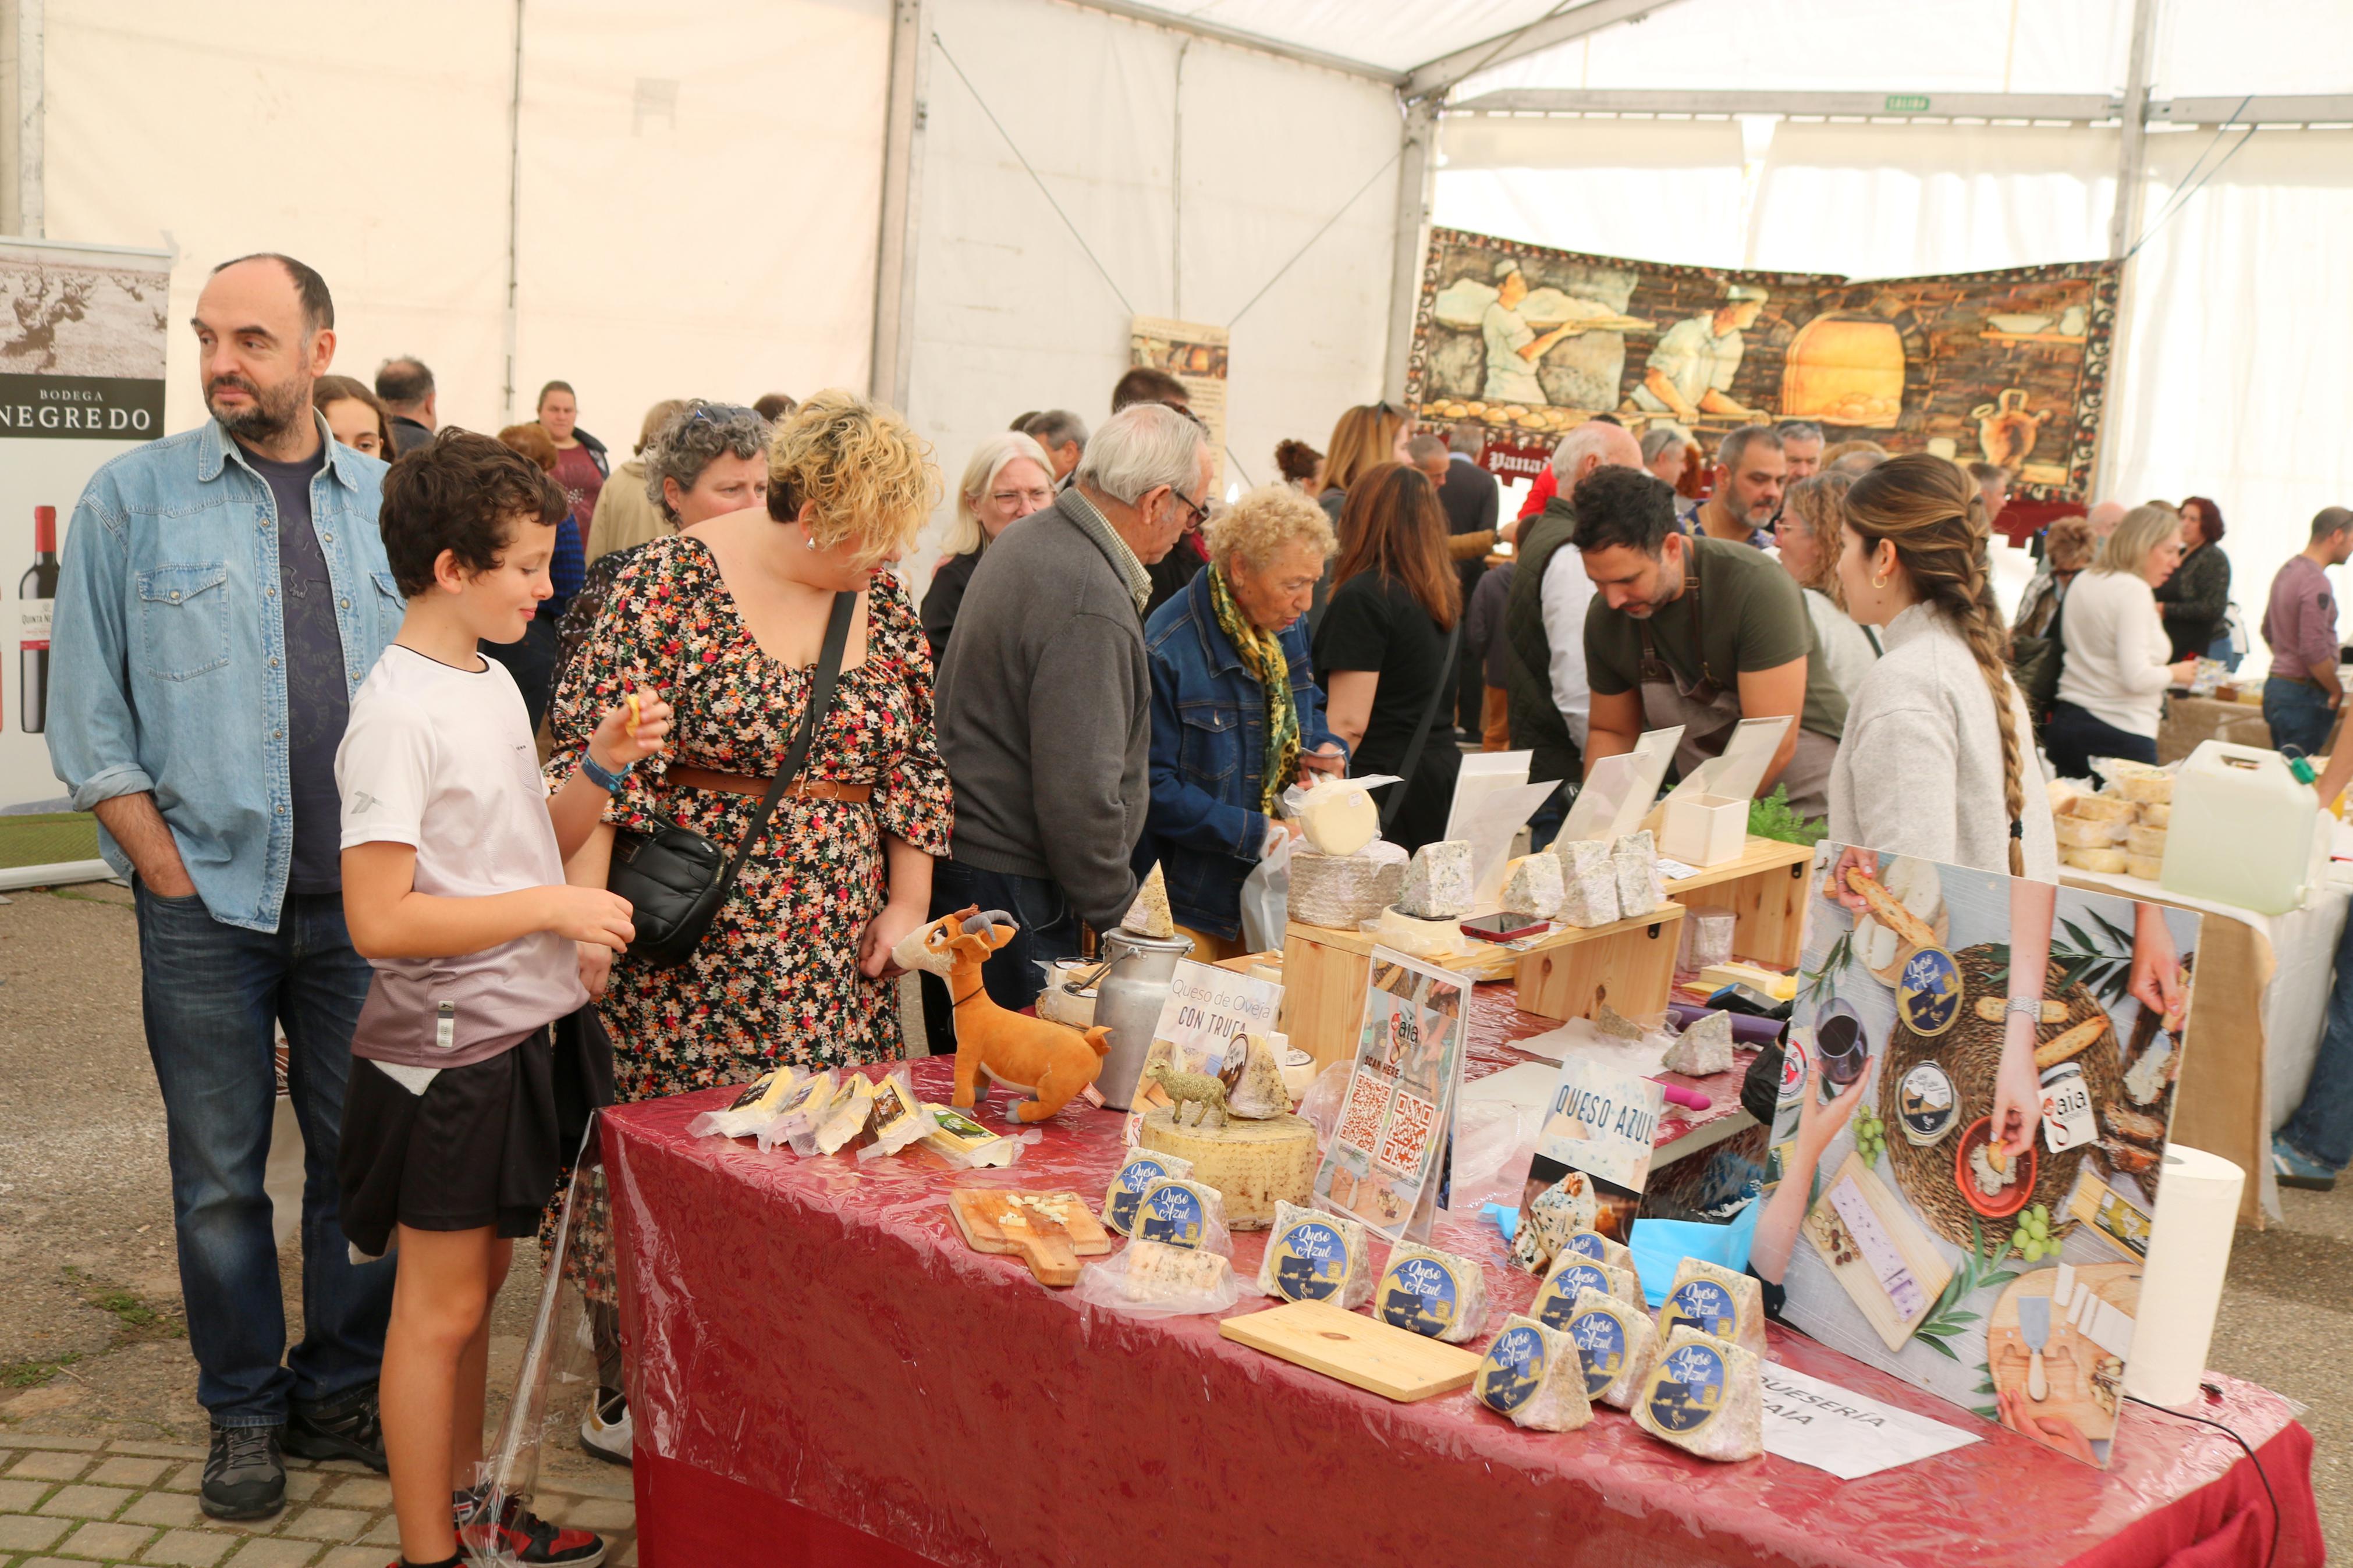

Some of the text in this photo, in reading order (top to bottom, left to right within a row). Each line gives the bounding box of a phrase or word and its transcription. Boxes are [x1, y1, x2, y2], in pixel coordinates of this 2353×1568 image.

[40, 389, 103, 401] BODEGA
[1172, 979, 1270, 1019] Queso de Oveja
[1178, 1006, 1205, 1030] CON
[1364, 1054, 1400, 1079] SCAN HERE
[1556, 1085, 1653, 1145] QUESO AZUL
[1131, 1163, 1158, 1178] Queso
[1160, 1187, 1189, 1206] Queso
[1158, 1202, 1190, 1221] Azul
[1298, 1225, 1331, 1243] Queso
[1296, 1240, 1332, 1258] Azul
[1408, 1260, 1442, 1280] Queso
[1568, 1266, 1599, 1283] Queso
[1404, 1277, 1443, 1296] Azul
[1685, 1283, 1719, 1300] Queso
[1684, 1299, 1721, 1318] Azul
[1582, 1313, 1613, 1332] Queso
[1501, 1332, 1531, 1352] Queso
[1577, 1331, 1613, 1350] Azul
[1500, 1345, 1532, 1367] Azul
[1678, 1346, 1712, 1366] Queso
[1673, 1364, 1712, 1384] Azul
[1762, 1398, 1814, 1425] AIA
